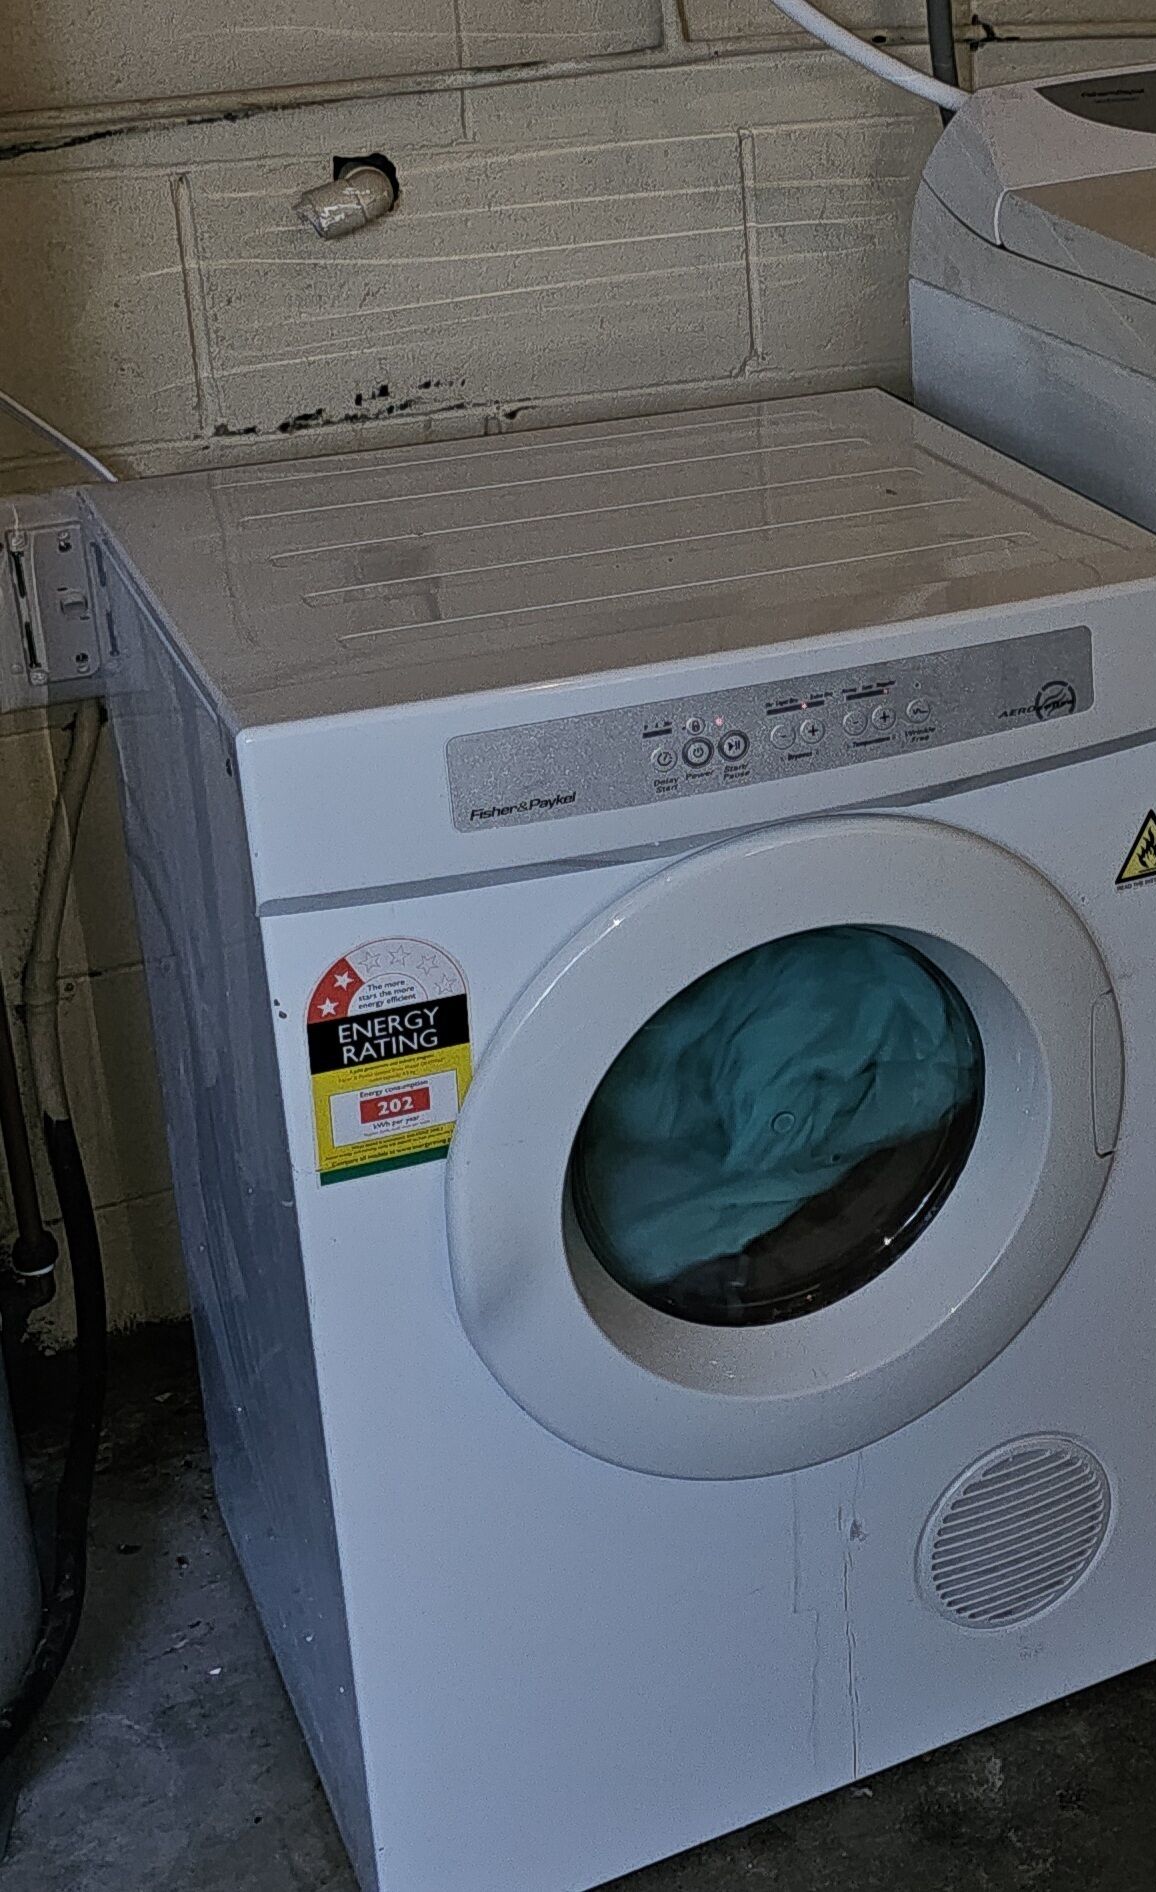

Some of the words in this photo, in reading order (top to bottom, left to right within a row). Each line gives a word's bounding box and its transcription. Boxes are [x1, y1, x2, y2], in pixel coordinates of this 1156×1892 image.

[653, 777, 679, 787] Delay
[655, 783, 679, 794] Start
[358, 993, 378, 1002] stars
[379, 989, 393, 998] the
[394, 985, 415, 995] more
[368, 984, 383, 992] The
[384, 980, 406, 989] more
[358, 1000, 385, 1010] energy
[386, 993, 417, 1005] efficient
[338, 1006, 439, 1044] ENERGY
[342, 1028, 438, 1065] RATING
[377, 1096, 414, 1116] 202
[372, 1120, 391, 1130] kWh
